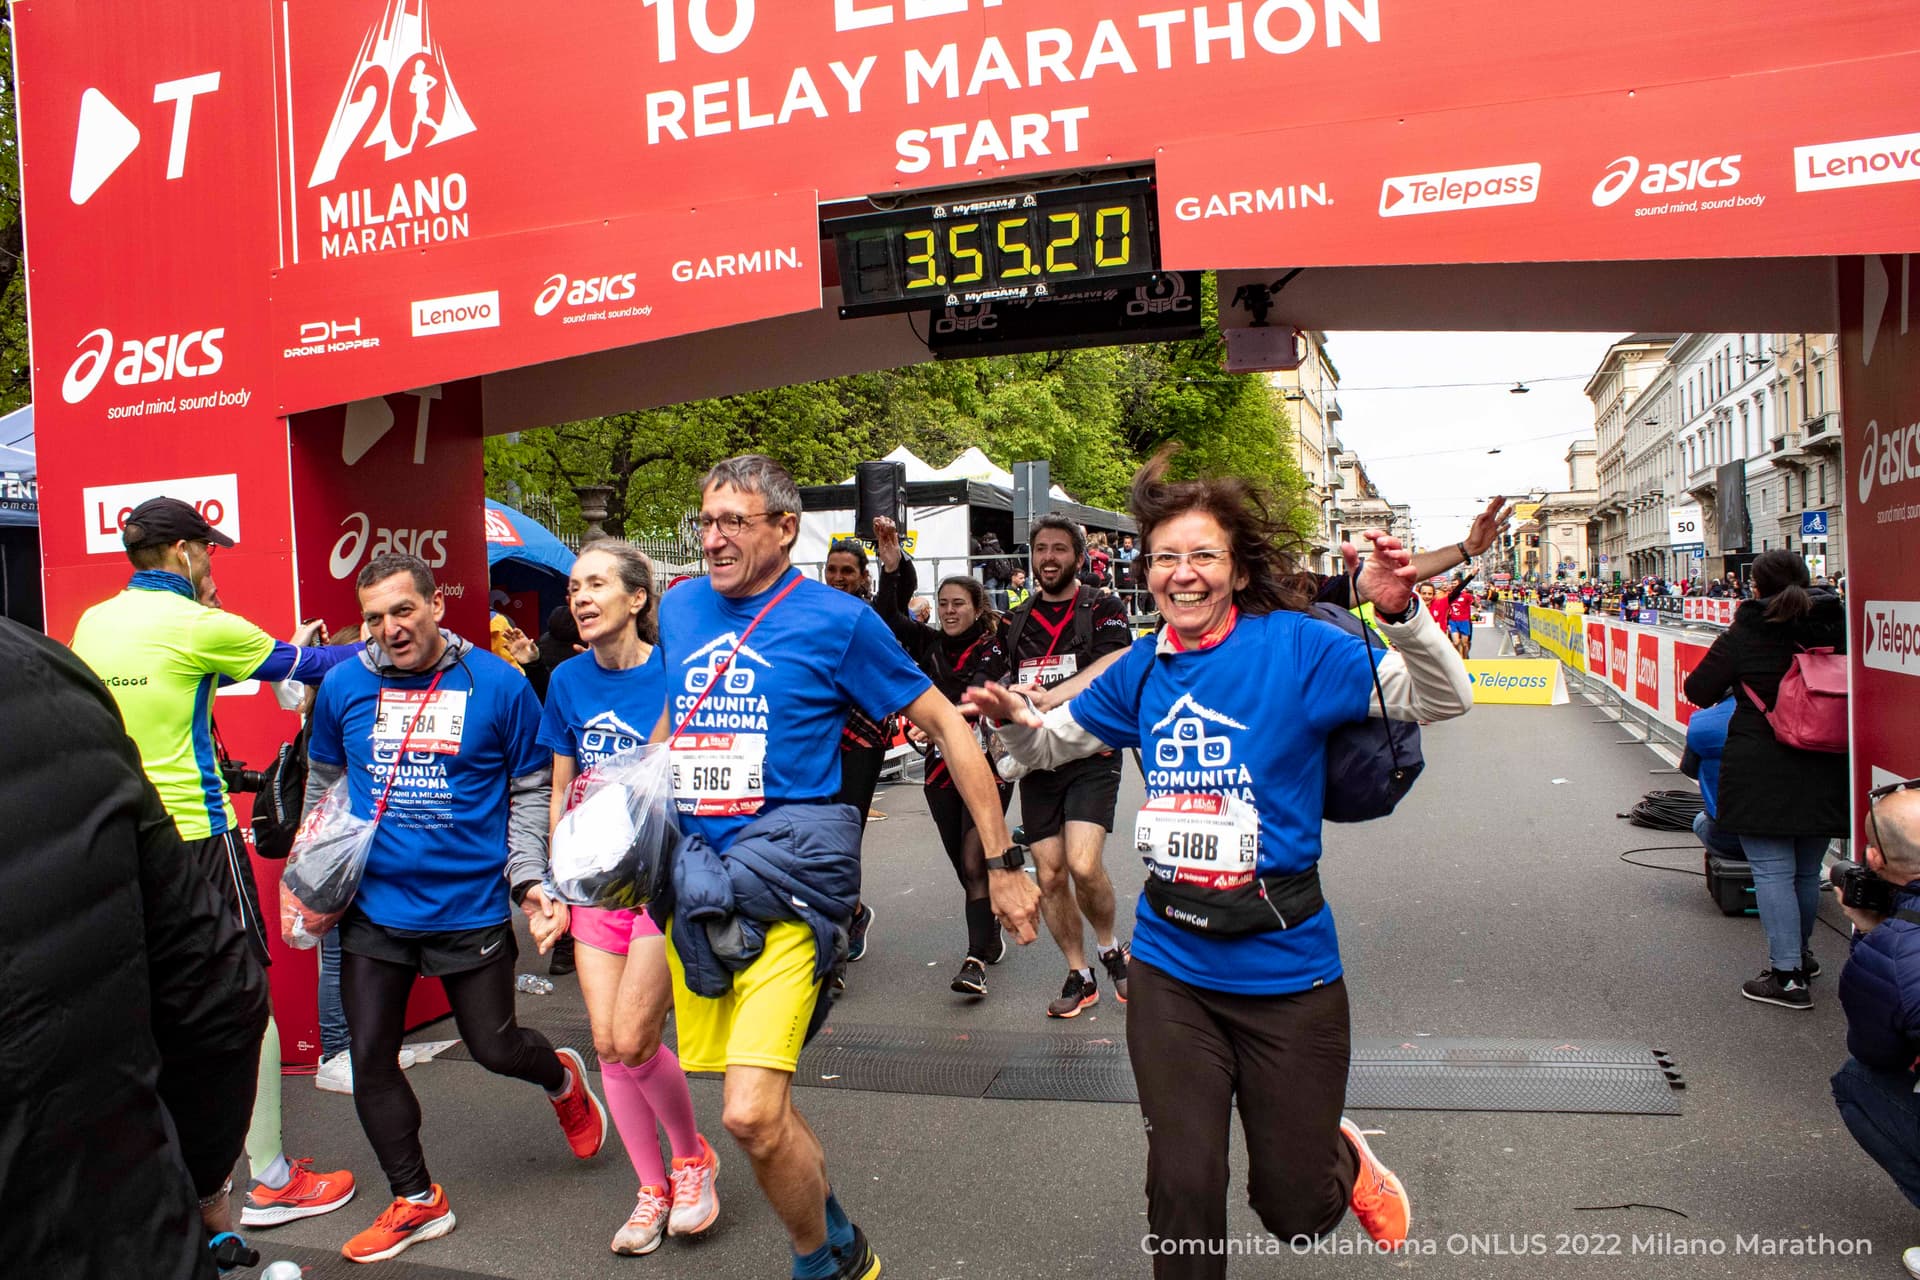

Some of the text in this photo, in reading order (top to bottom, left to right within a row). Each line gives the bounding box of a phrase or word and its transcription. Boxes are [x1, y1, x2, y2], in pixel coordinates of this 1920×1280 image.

[646, 0, 1381, 145] RELAY MARATHON
[895, 106, 1089, 173] START
[1409, 175, 1534, 205] Telepass
[320, 173, 468, 233] MILANO
[1634, 193, 1766, 217] sound mind, sound body
[321, 212, 469, 260] MARATHON
[419, 304, 492, 326] Lenovo
[562, 313, 587, 324] sound
[608, 307, 632, 319] sound
[632, 304, 653, 317] body
[284, 337, 380, 358] DRONE HOPPER
[107, 388, 252, 419] sound mind, sound body
[1879, 421, 1920, 486] asic
[1677, 521, 1695, 533] 50
[444, 583, 465, 599] body
[1479, 672, 1548, 691] Telepass
[1637, 648, 1657, 691] Lenovo
[675, 694, 769, 714] COMUNITÀ
[693, 766, 732, 791] 518C
[1148, 764, 1253, 788] COMUNITÀ
[420, 791, 453, 800] MILANO
[1167, 831, 1219, 861] 518B
